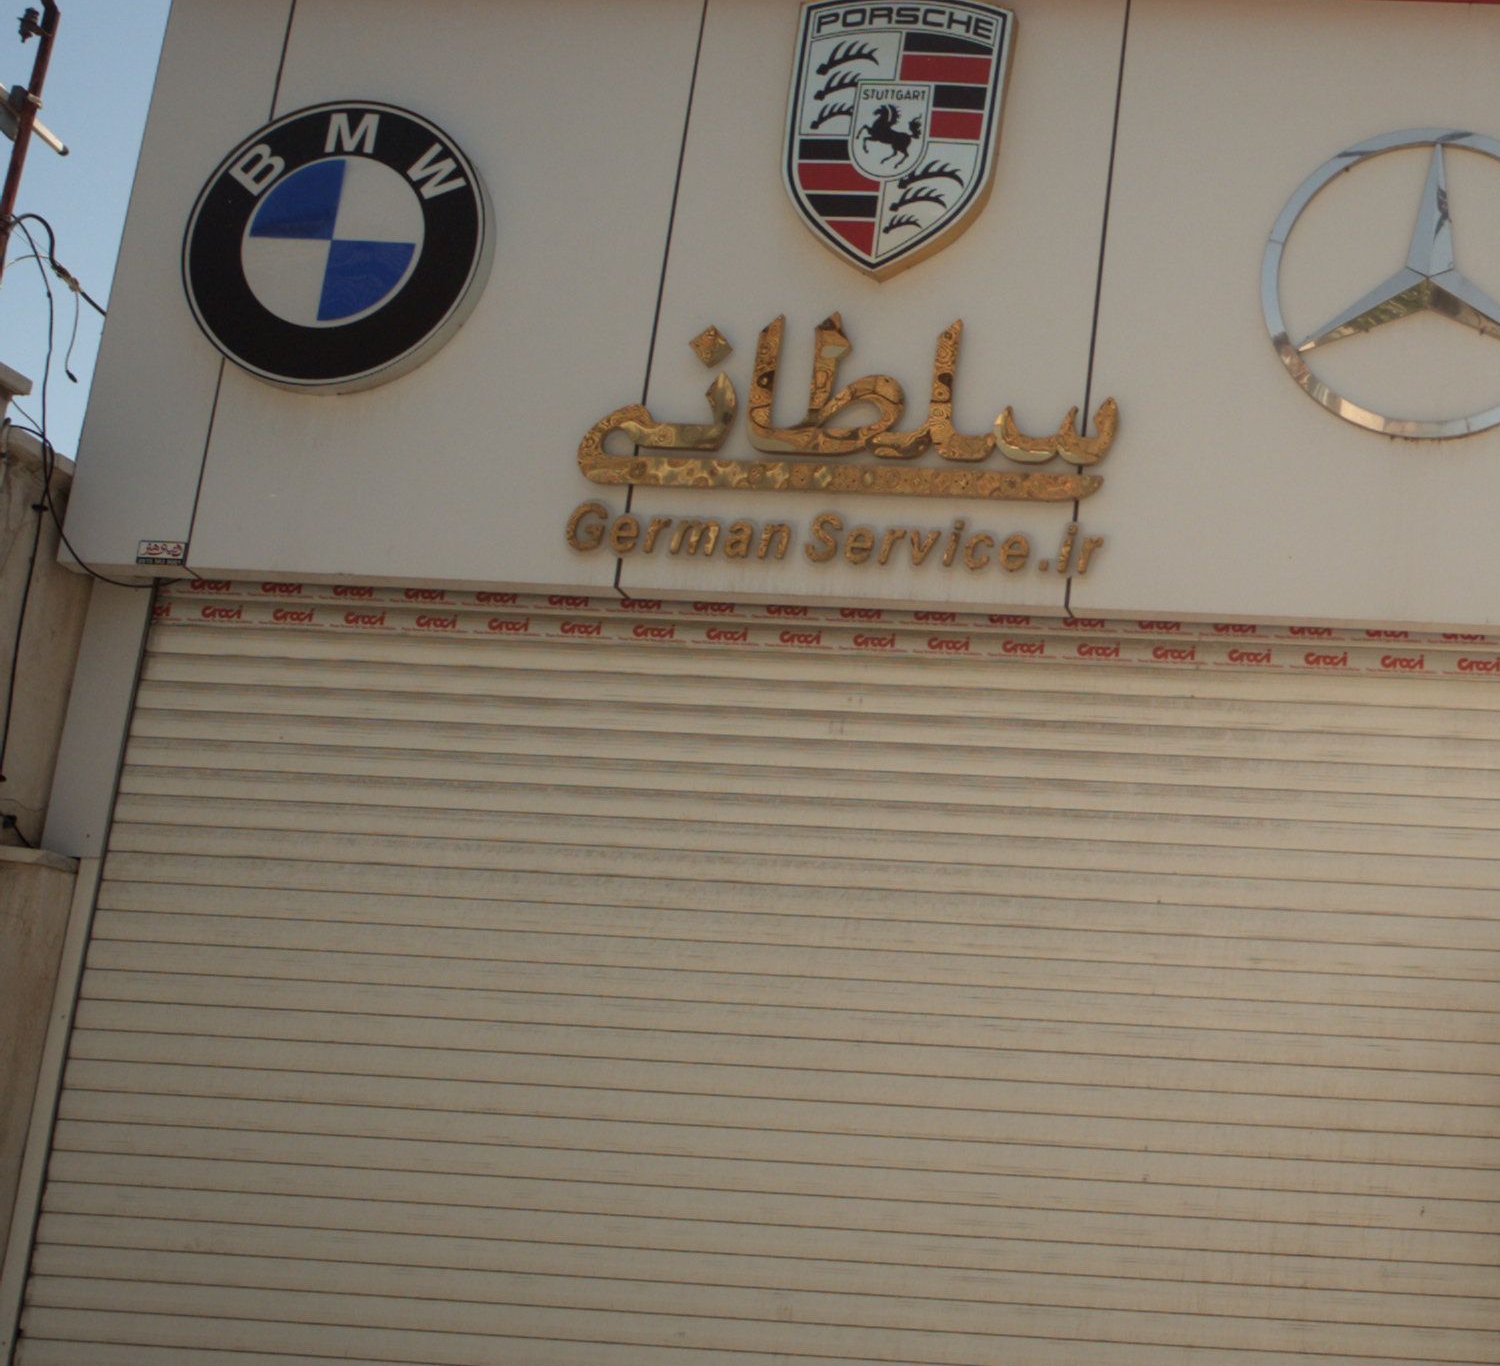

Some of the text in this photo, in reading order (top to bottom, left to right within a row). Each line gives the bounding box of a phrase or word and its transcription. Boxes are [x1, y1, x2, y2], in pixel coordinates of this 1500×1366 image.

[815, 6, 994, 40] PORSCHE
[862, 87, 927, 102] STUTTGART
[228, 112, 467, 200] BMW
